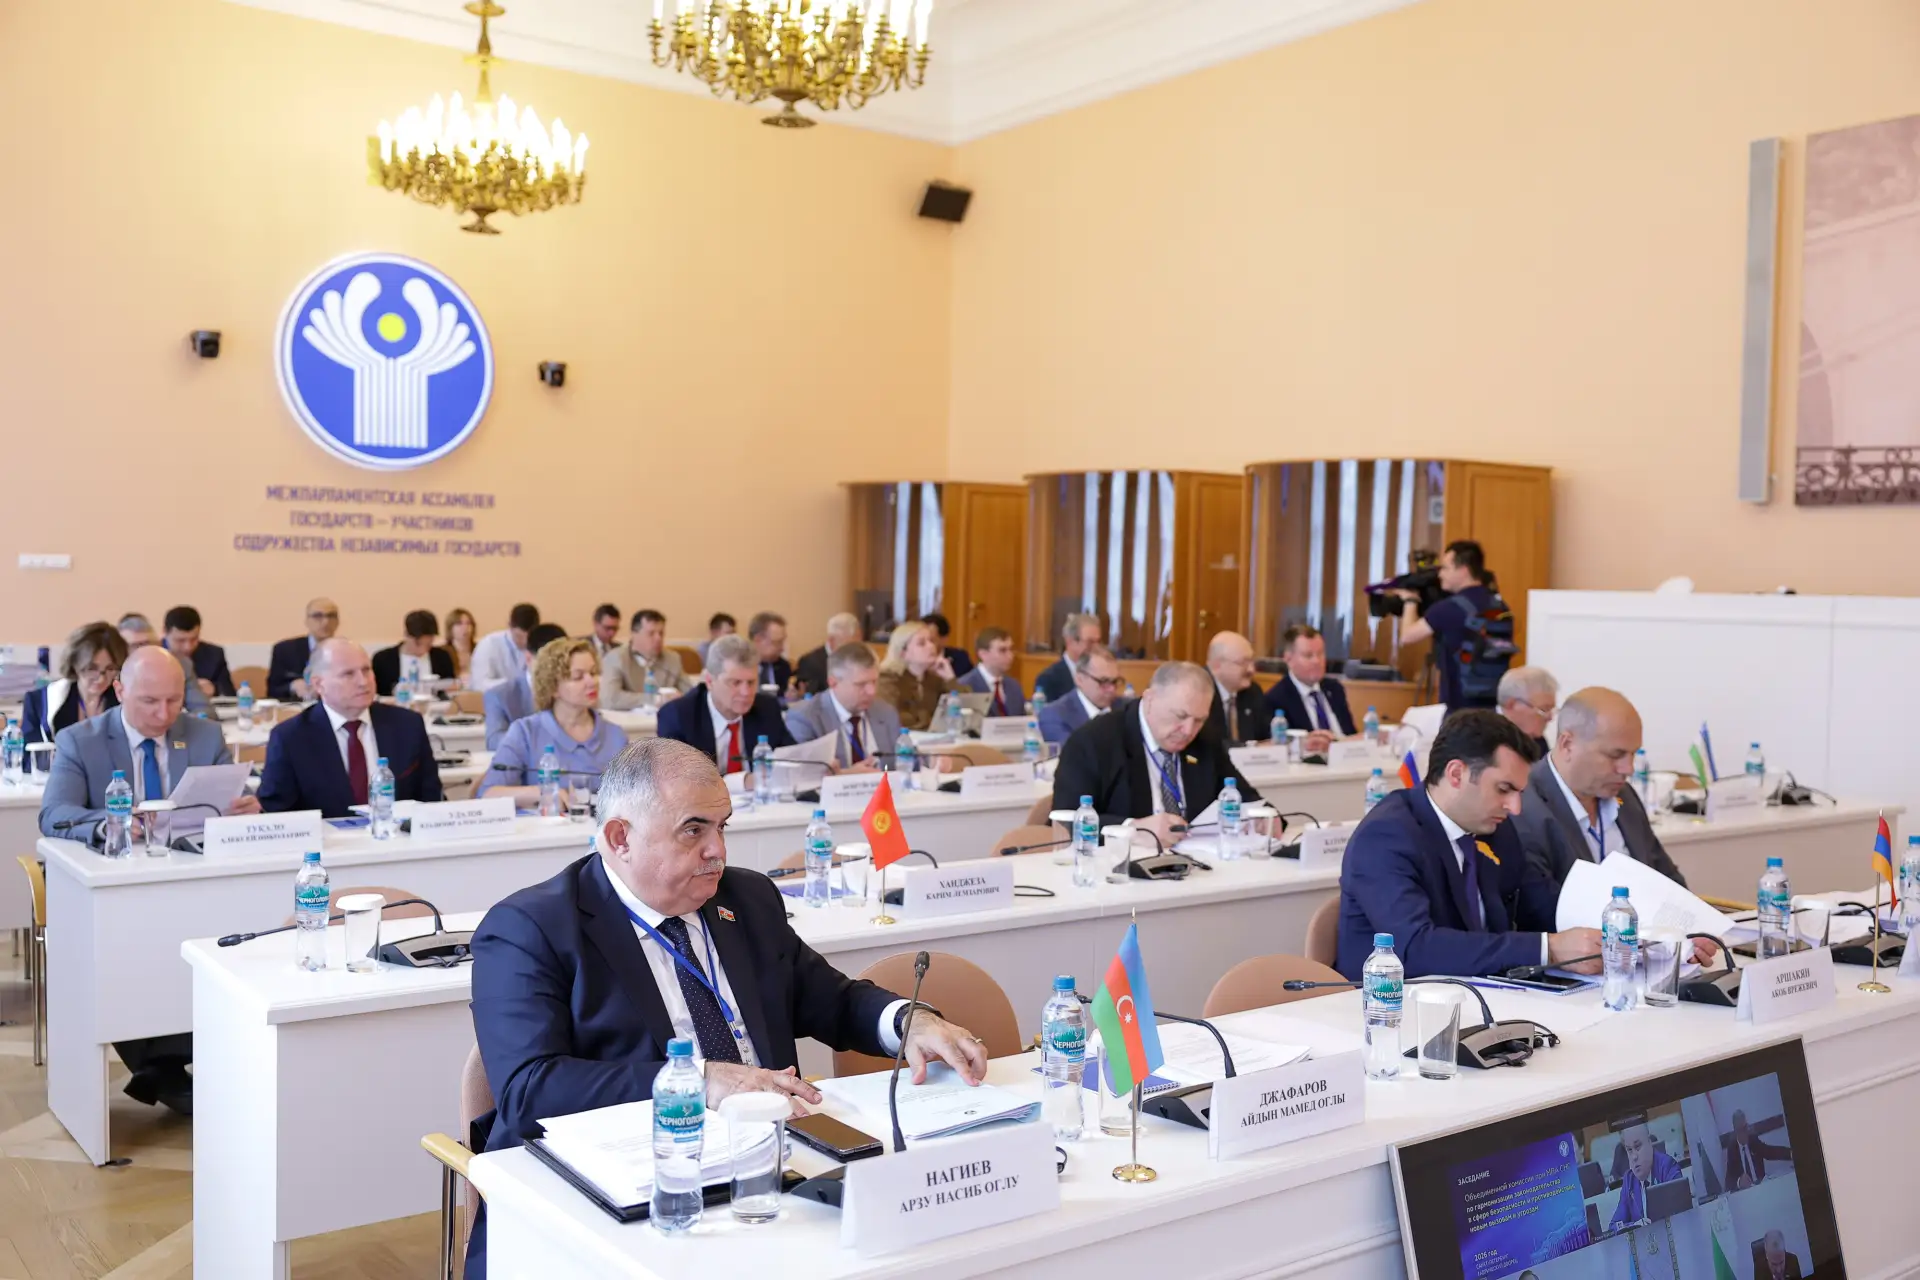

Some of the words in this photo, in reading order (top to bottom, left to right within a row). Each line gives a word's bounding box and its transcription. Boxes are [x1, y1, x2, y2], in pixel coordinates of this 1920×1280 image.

[1776, 968, 1810, 984] АРШАКЯН
[1260, 1080, 1327, 1107] ДЖАФАРОВ
[1241, 1109, 1278, 1127] АЙДЫН
[1280, 1100, 1317, 1118] МАМЕД
[1318, 1093, 1345, 1109] ОГЛЫ
[926, 1160, 991, 1187] НАГИЕВ
[1458, 1170, 1490, 1186] ЗАСЕДАНИЕ
[900, 1195, 932, 1213] АРЗУ
[936, 1184, 982, 1205] НАСИБ
[984, 1175, 1019, 1193] ОГЛУ
[1474, 1250, 1487, 1262] 2026
